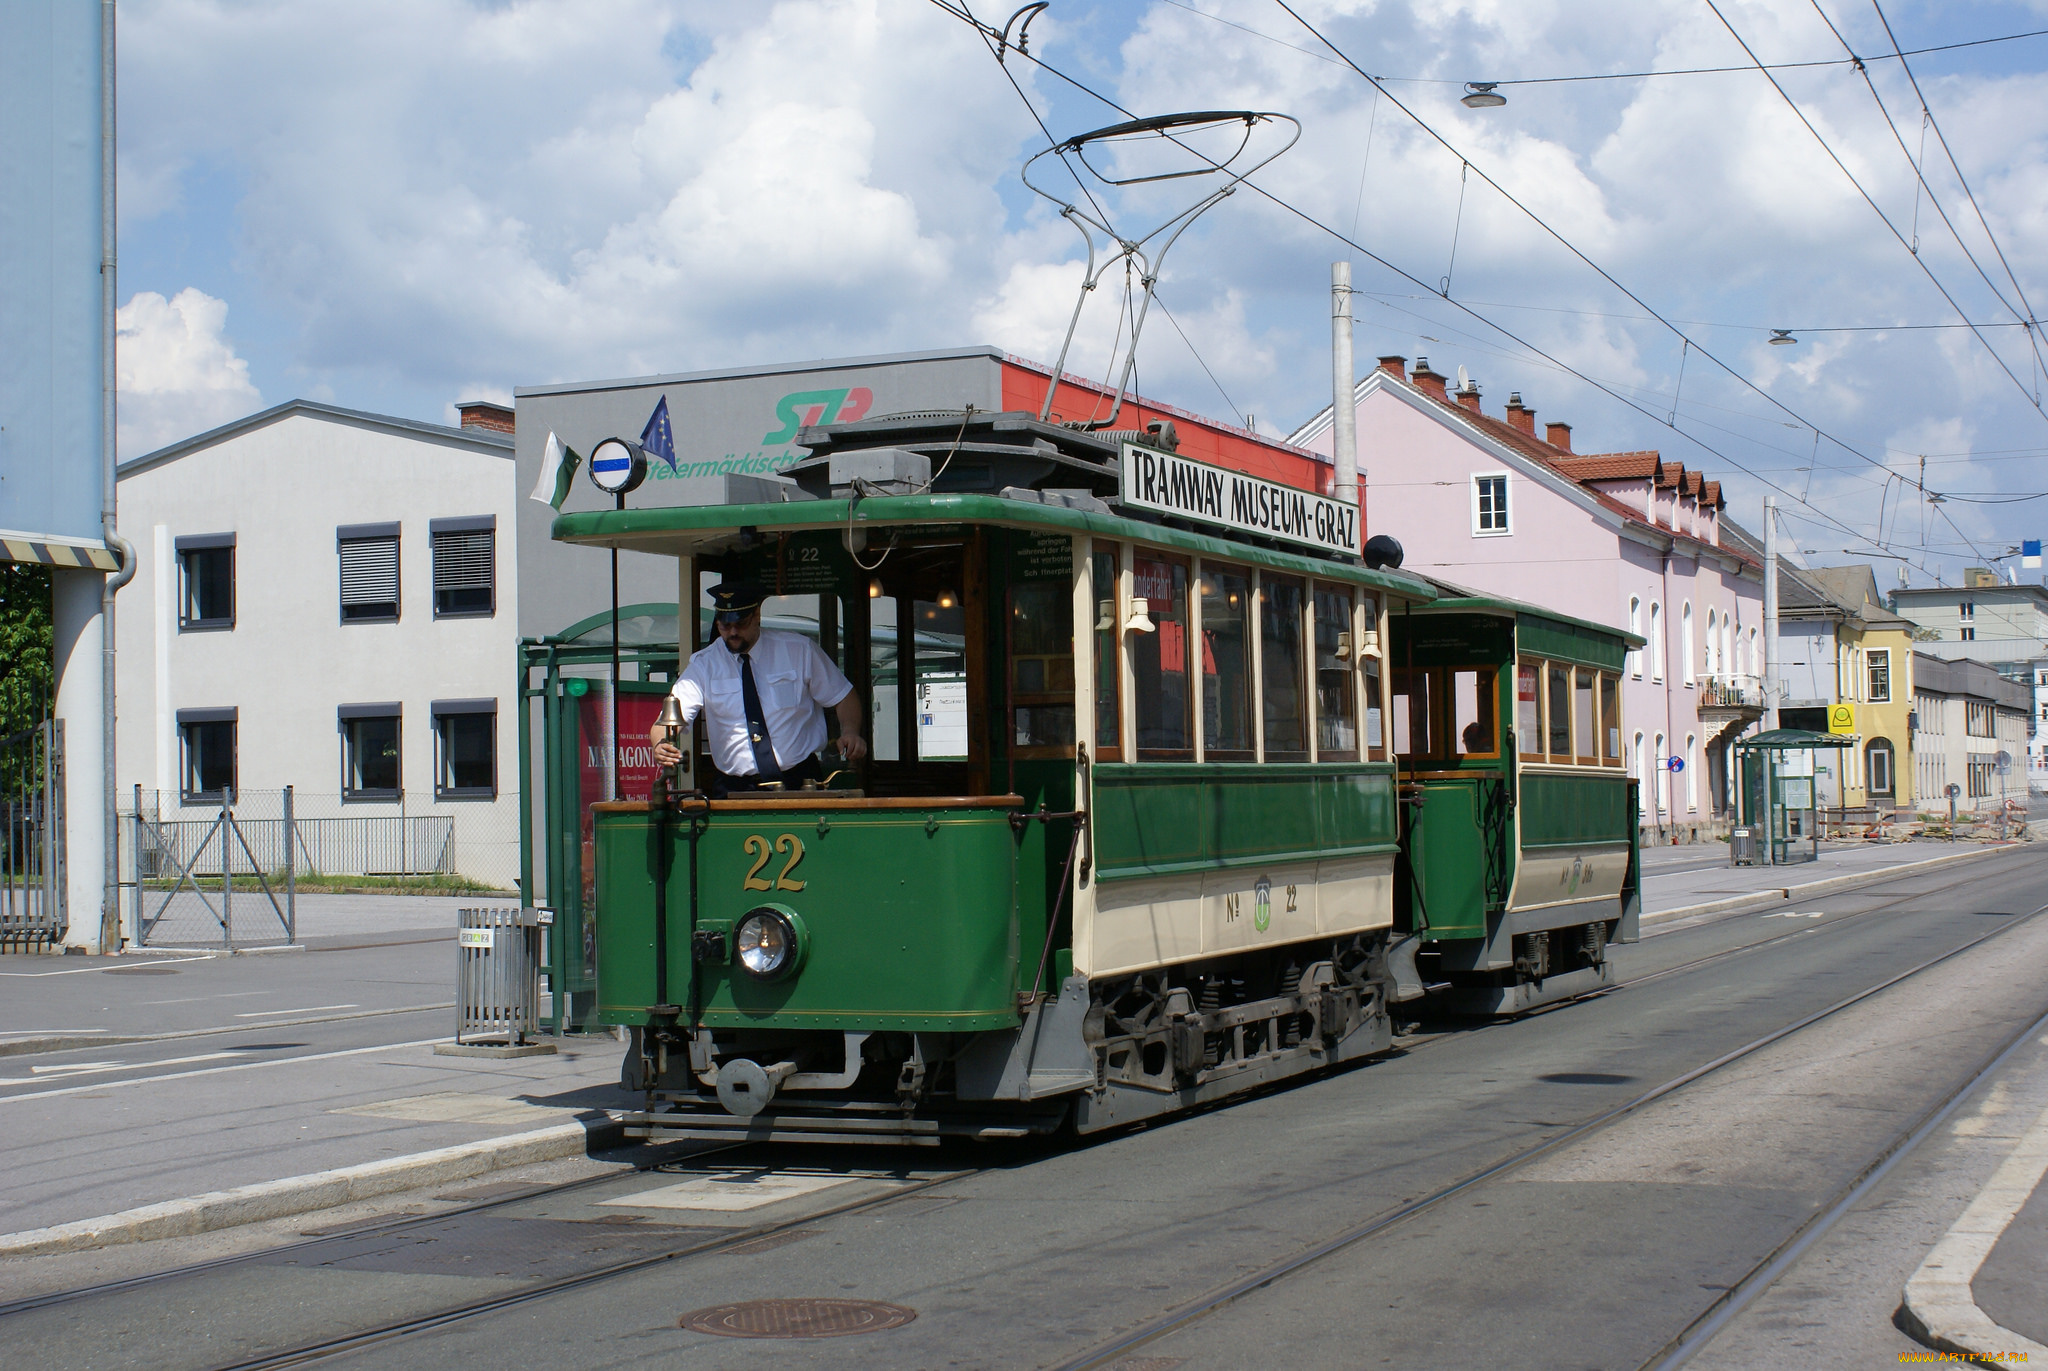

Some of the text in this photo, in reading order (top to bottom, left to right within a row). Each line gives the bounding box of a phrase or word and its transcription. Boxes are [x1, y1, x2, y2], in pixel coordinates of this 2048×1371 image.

[1132, 449, 1355, 549] TRAMWAY MUSEUM-GRAZ
[801, 547, 819, 562] 22
[1047, 546, 1059, 554] der
[1134, 567, 1172, 600] onderfahrt
[743, 833, 808, 893] 22
[1286, 884, 1297, 913] 22
